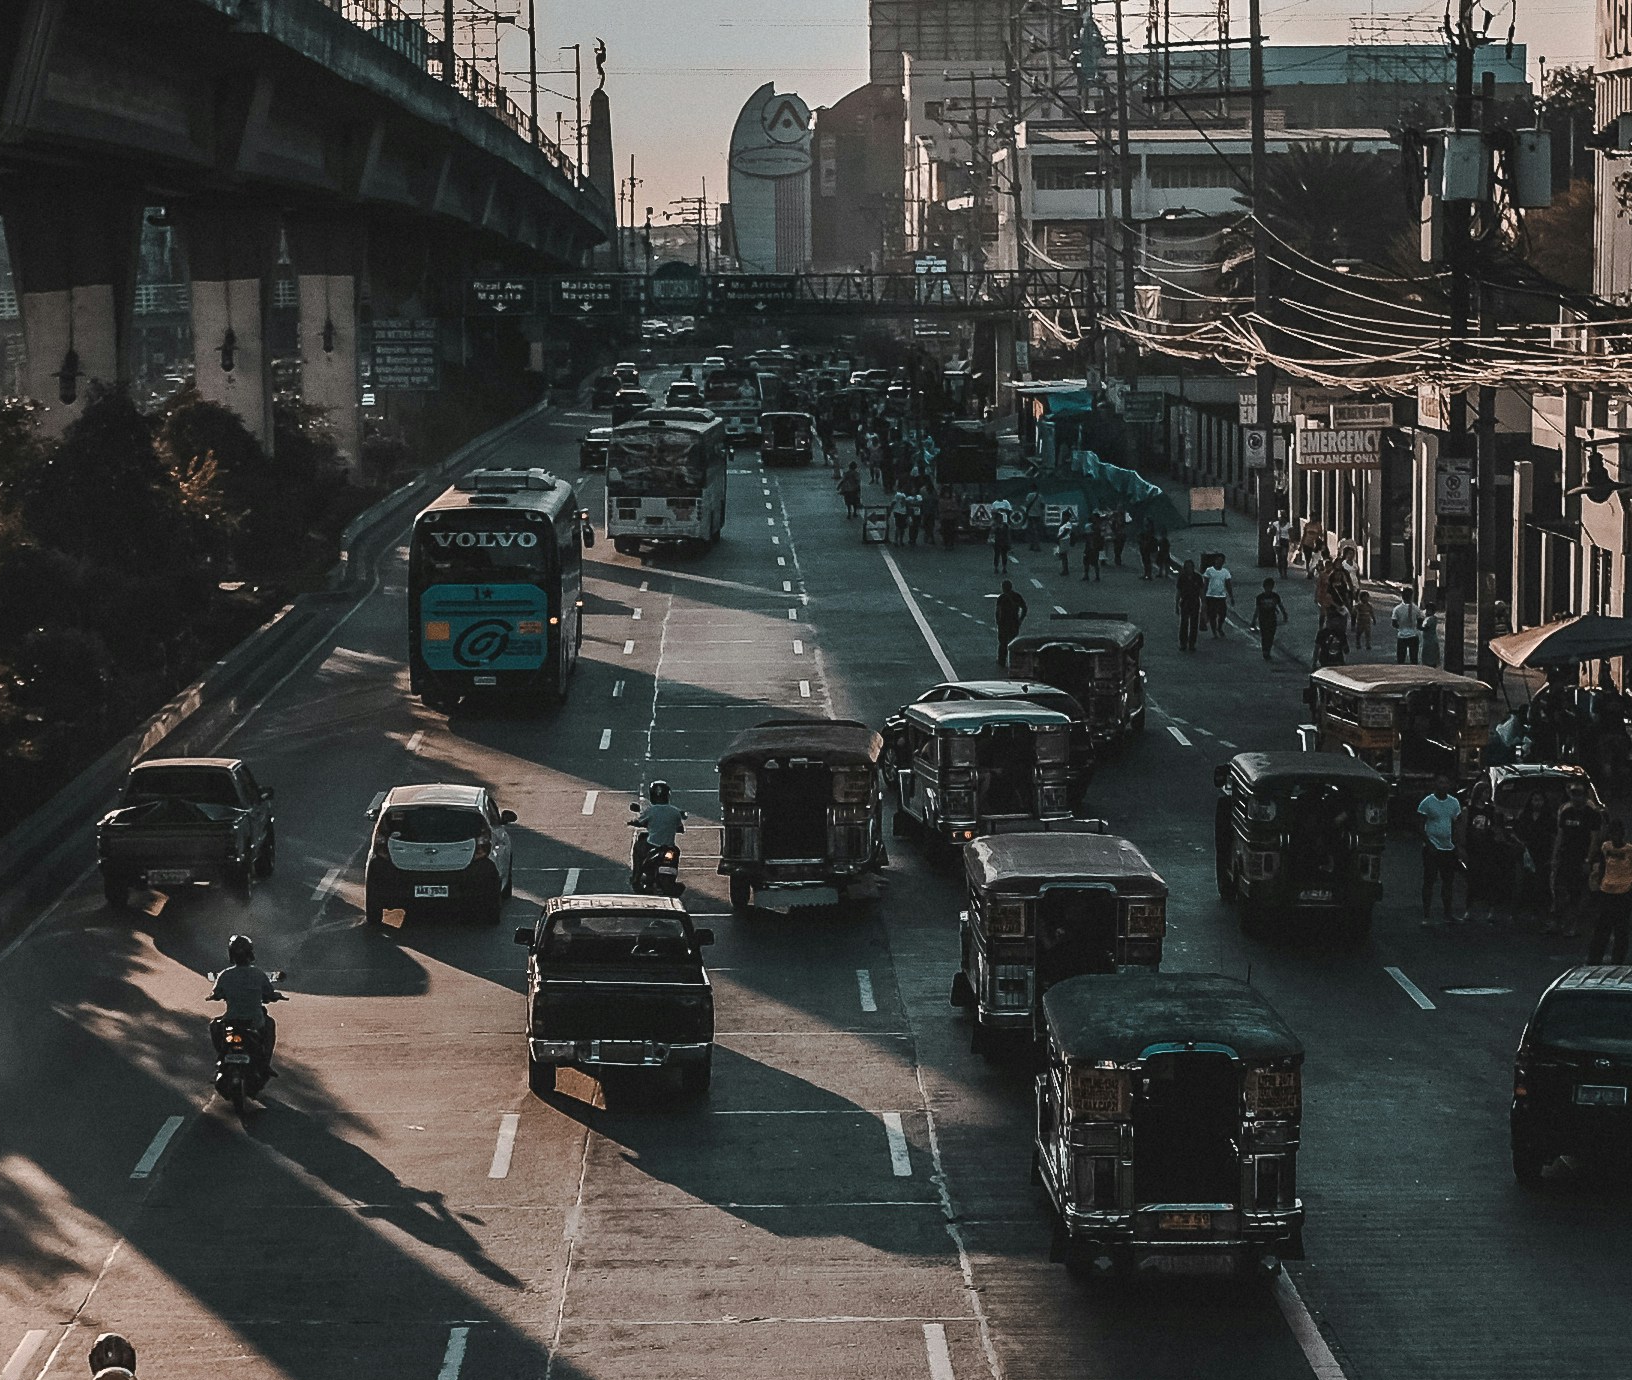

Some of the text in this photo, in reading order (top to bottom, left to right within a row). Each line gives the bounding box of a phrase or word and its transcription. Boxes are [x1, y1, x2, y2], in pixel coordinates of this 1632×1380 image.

[473, 281, 501, 290] Rizal
[561, 281, 612, 290] Malabon
[477, 292, 522, 301] Manila
[562, 292, 611, 300] Navotas
[1299, 430, 1381, 452] EMERGENCY
[1299, 453, 1380, 464] ENTRANCE ONLY
[430, 532, 538, 547] VOLVO
